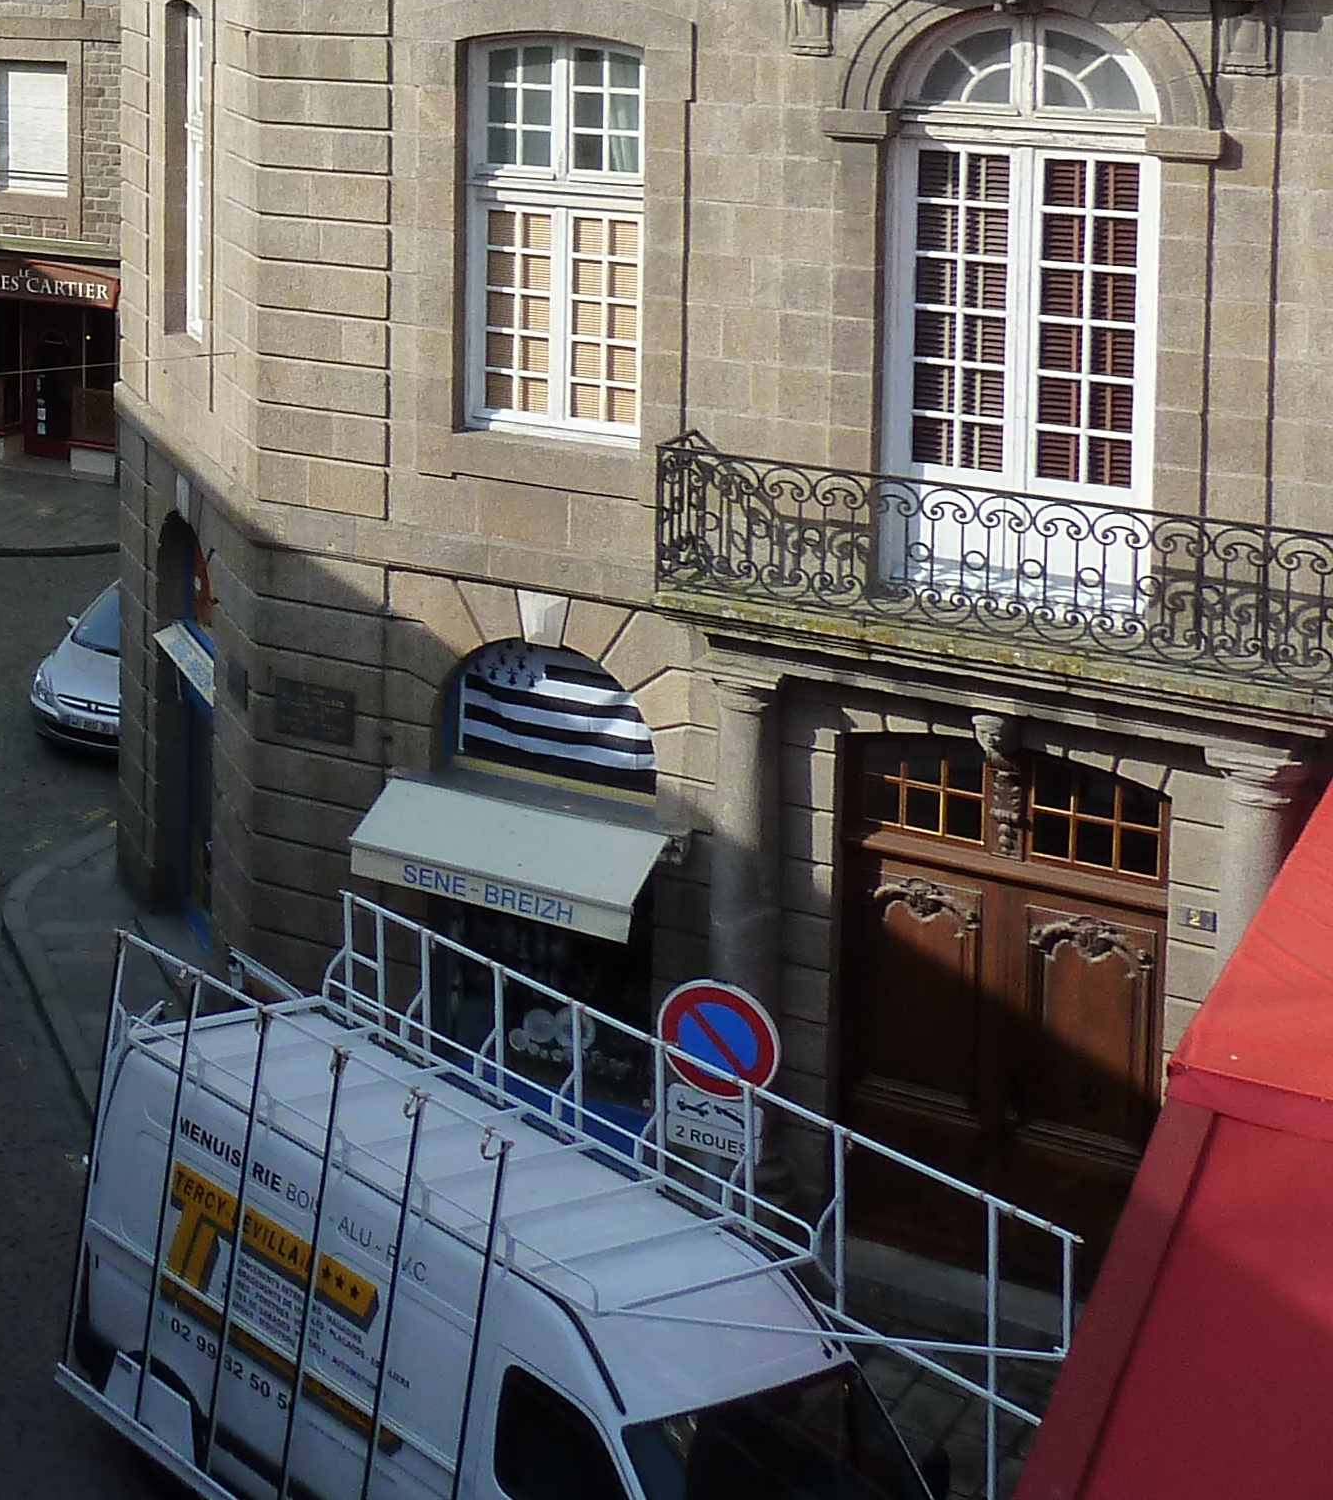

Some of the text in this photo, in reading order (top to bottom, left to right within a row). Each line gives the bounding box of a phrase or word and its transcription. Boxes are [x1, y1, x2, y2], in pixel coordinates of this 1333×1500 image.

[18, 268, 31, 278] LE
[26, 277, 109, 300] CARTIER
[484, 883, 574, 924] BREIZH
[675, 1124, 746, 1156] 2 ROUES
[180, 1115, 283, 1193] MENUISRIE
[337, 1215, 373, 1248] ALU
[171, 1317, 191, 1343] 02
[196, 1335, 217, 1360] 99
[250, 1372, 271, 1398] 50
[277, 1390, 292, 1414] 5
